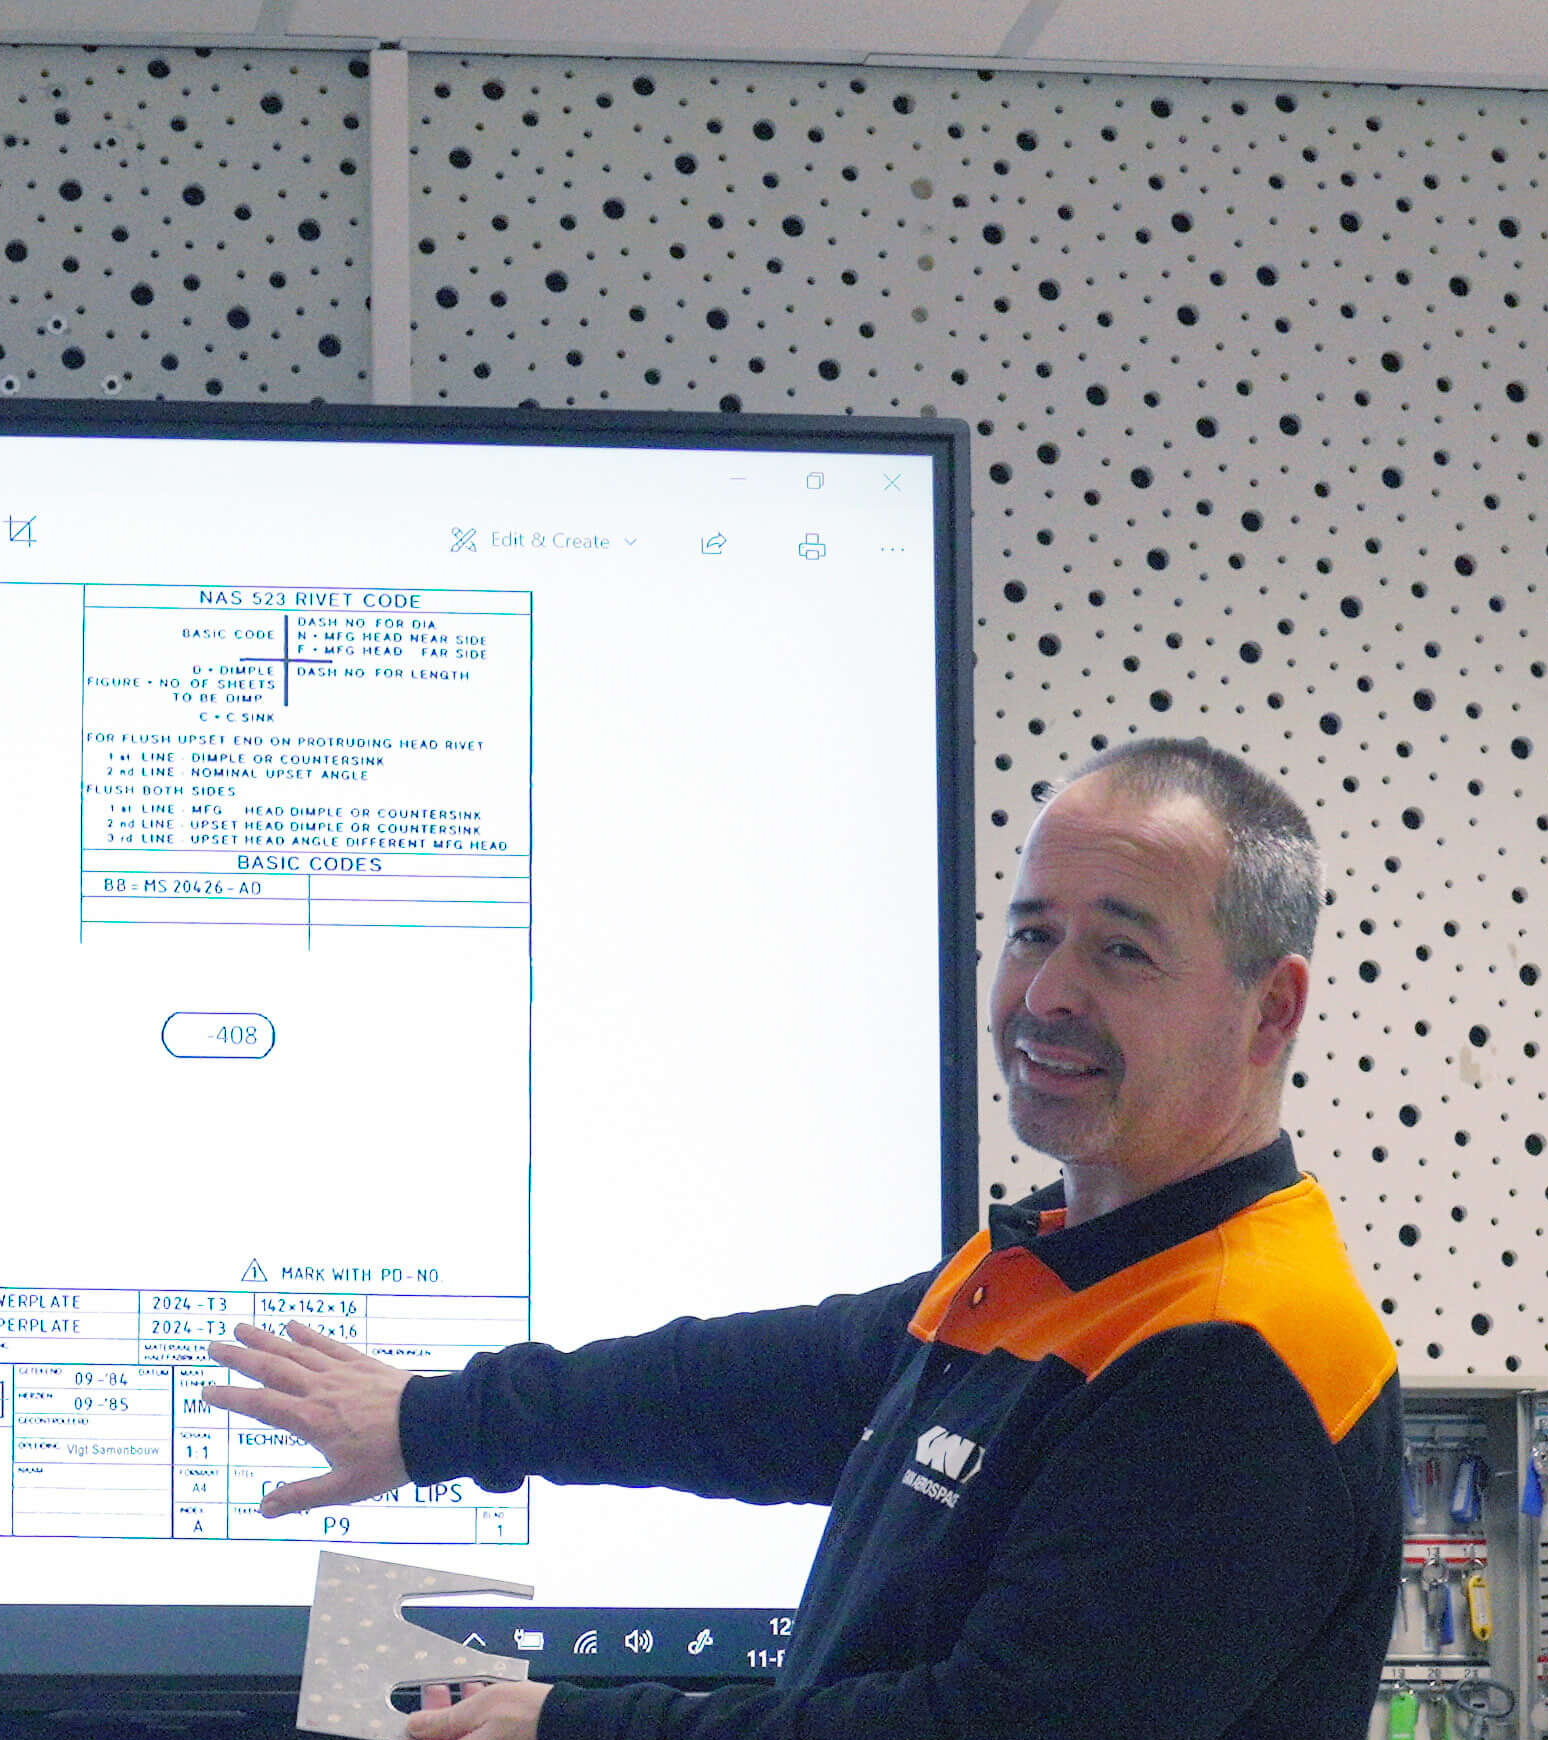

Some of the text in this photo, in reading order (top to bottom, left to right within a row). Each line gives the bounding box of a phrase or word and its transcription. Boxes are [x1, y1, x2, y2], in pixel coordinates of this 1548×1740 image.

[491, 531, 610, 550] Edit & Create
[199, 590, 422, 609] NAS 523 RIVET CODE
[182, 628, 275, 640] BASIC CODE
[86, 732, 115, 744] FOR
[177, 734, 226, 746] UPSET
[237, 854, 383, 872] BASIC CODES
[103, 878, 127, 893] BB
[144, 879, 168, 893] MS
[209, 1025, 257, 1045] -408
[281, 1266, 326, 1281] MARK
[332, 1267, 374, 1282] WITH
[184, 1399, 211, 1414] MM
[91, 1444, 160, 1456] Samenbouw
[186, 1445, 208, 1459] 1:1
[192, 1482, 207, 1493] A4
[413, 1481, 463, 1503] LIPS
[193, 1519, 203, 1533] A
[323, 1516, 350, 1535] P9
